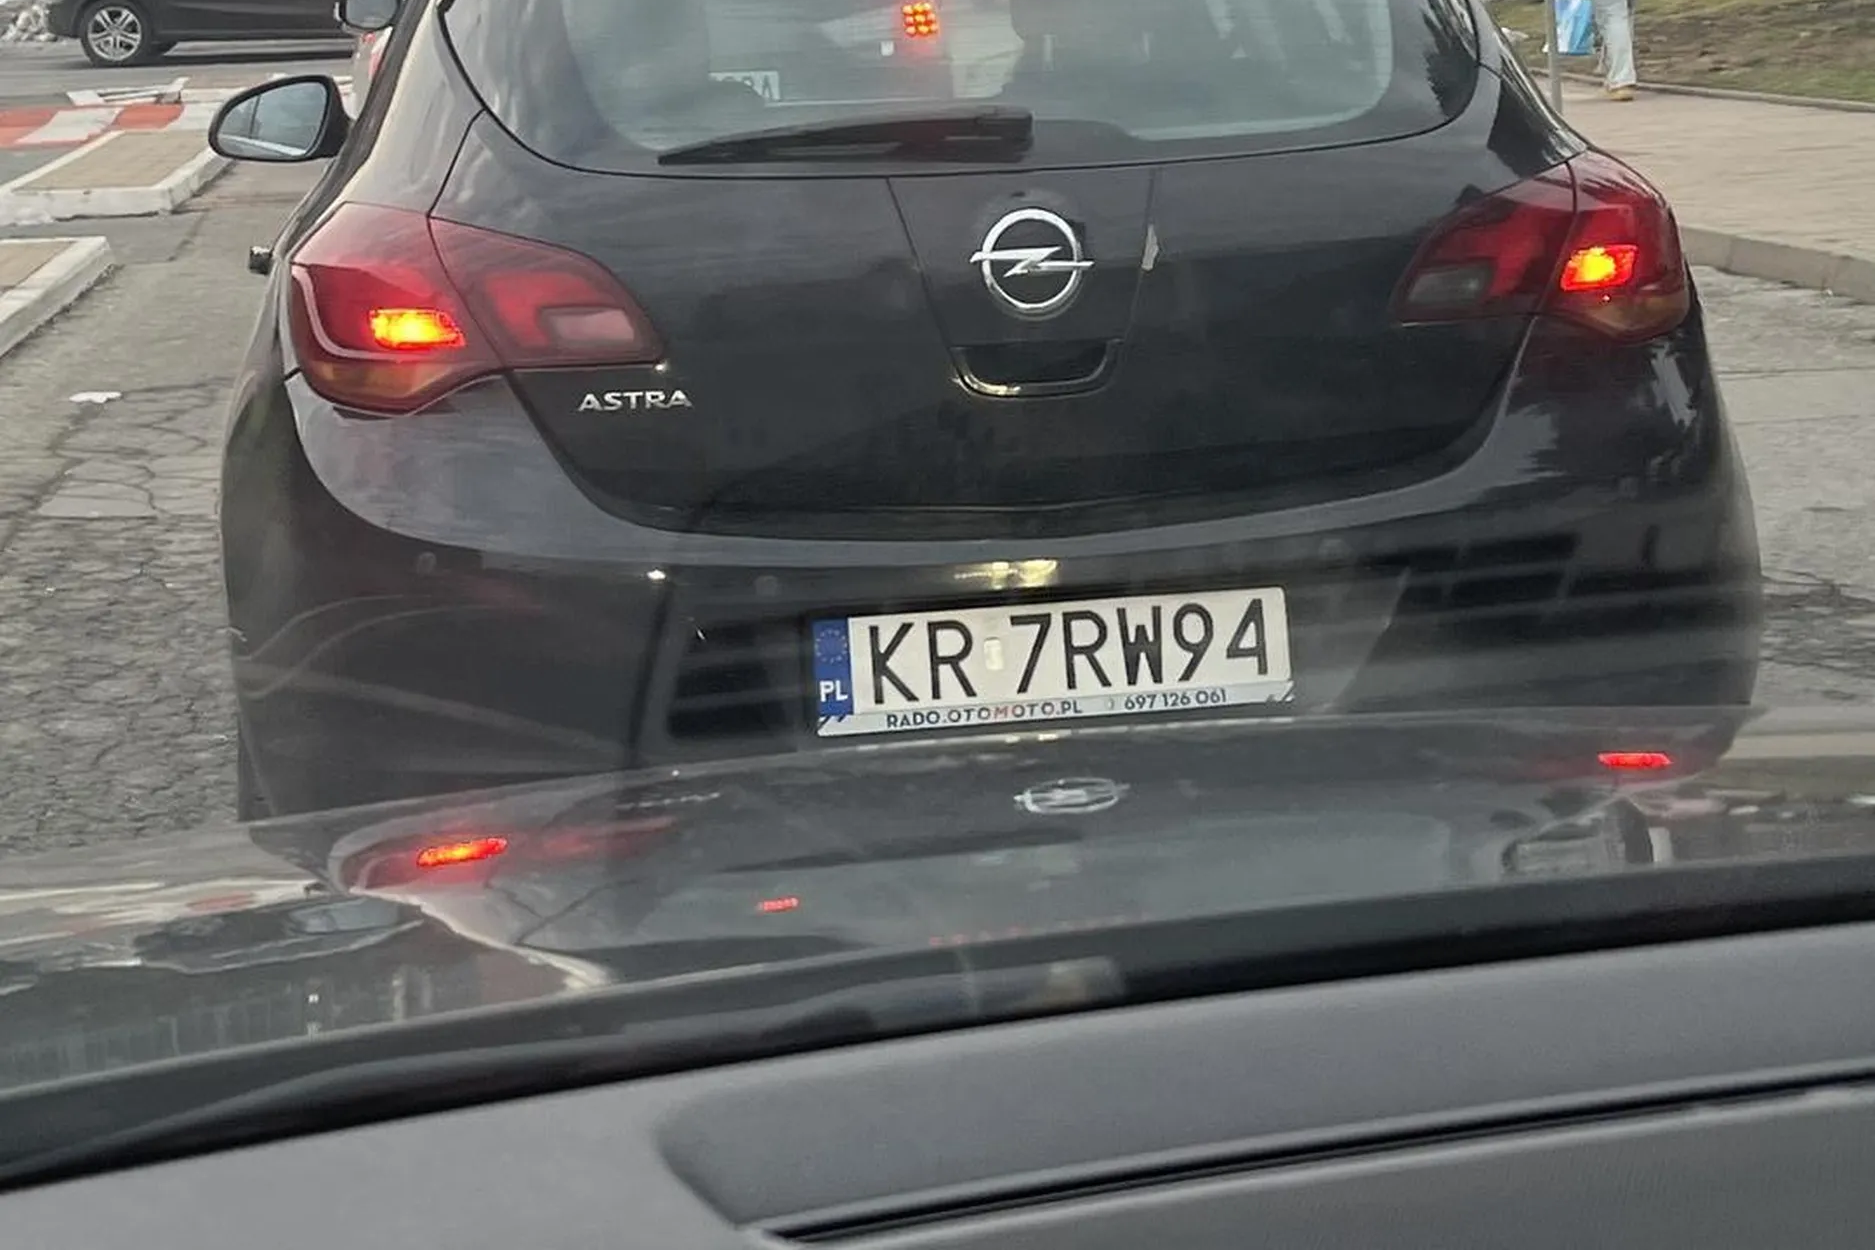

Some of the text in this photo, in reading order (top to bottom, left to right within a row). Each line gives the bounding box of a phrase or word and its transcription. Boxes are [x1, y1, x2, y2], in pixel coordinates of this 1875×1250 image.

[578, 390, 692, 411] ASTRA
[868, 598, 1268, 705] KR 7RW94
[818, 680, 848, 702] PL
[886, 689, 1227, 728] RADO.OTOMOTO.PL 697 126 061
